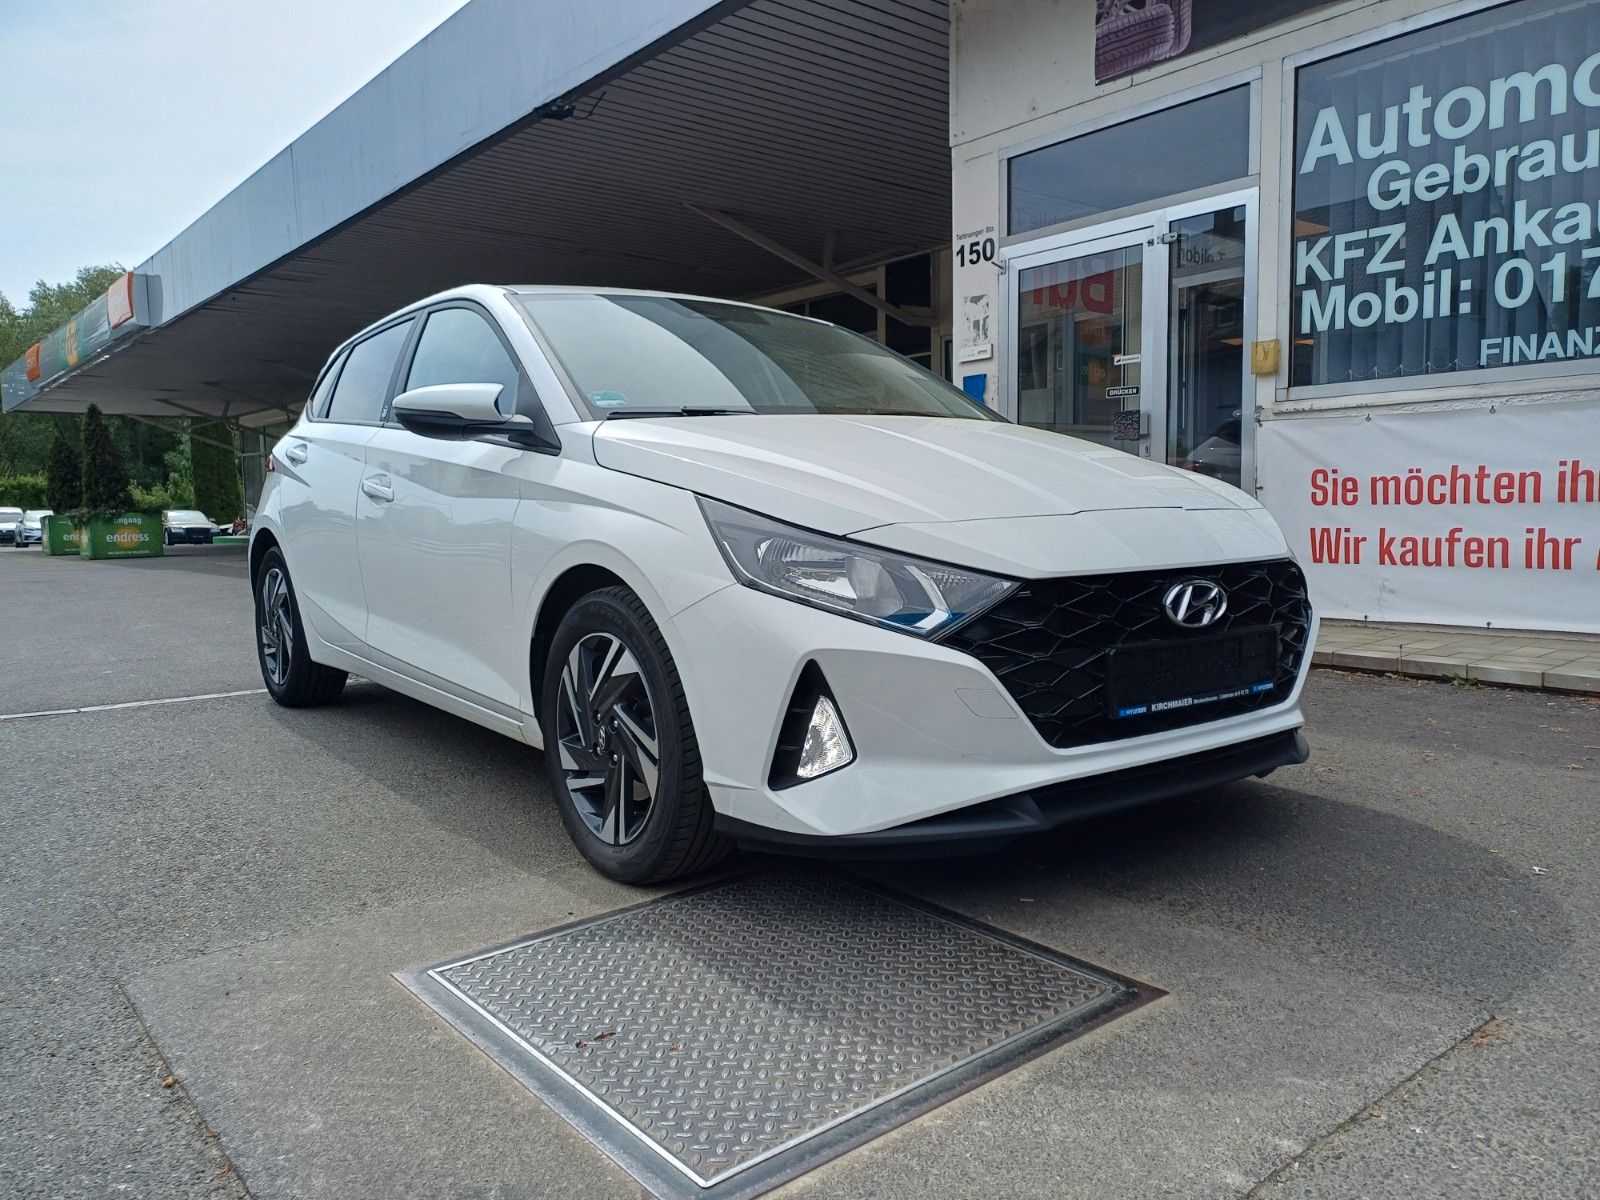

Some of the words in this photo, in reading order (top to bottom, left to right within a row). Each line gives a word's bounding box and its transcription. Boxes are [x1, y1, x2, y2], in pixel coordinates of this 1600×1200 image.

[1367, 129, 1600, 211] Gebrau
[956, 238, 995, 267] 150
[1296, 223, 1406, 286] KFZ
[1424, 199, 1600, 265] Anka
[1300, 268, 1471, 334] Mobil:
[1109, 388, 1137, 396] DRÜCKEN
[1310, 468, 1359, 506] Sie
[1370, 465, 1542, 505] möchten
[1558, 459, 1600, 503] ih
[106, 531, 149, 543] endress
[1309, 527, 1367, 565] Wir
[1379, 527, 1509, 568] kaufen
[1525, 527, 1582, 570] ihr
[1151, 697, 1193, 712] KIRCHMAIER
